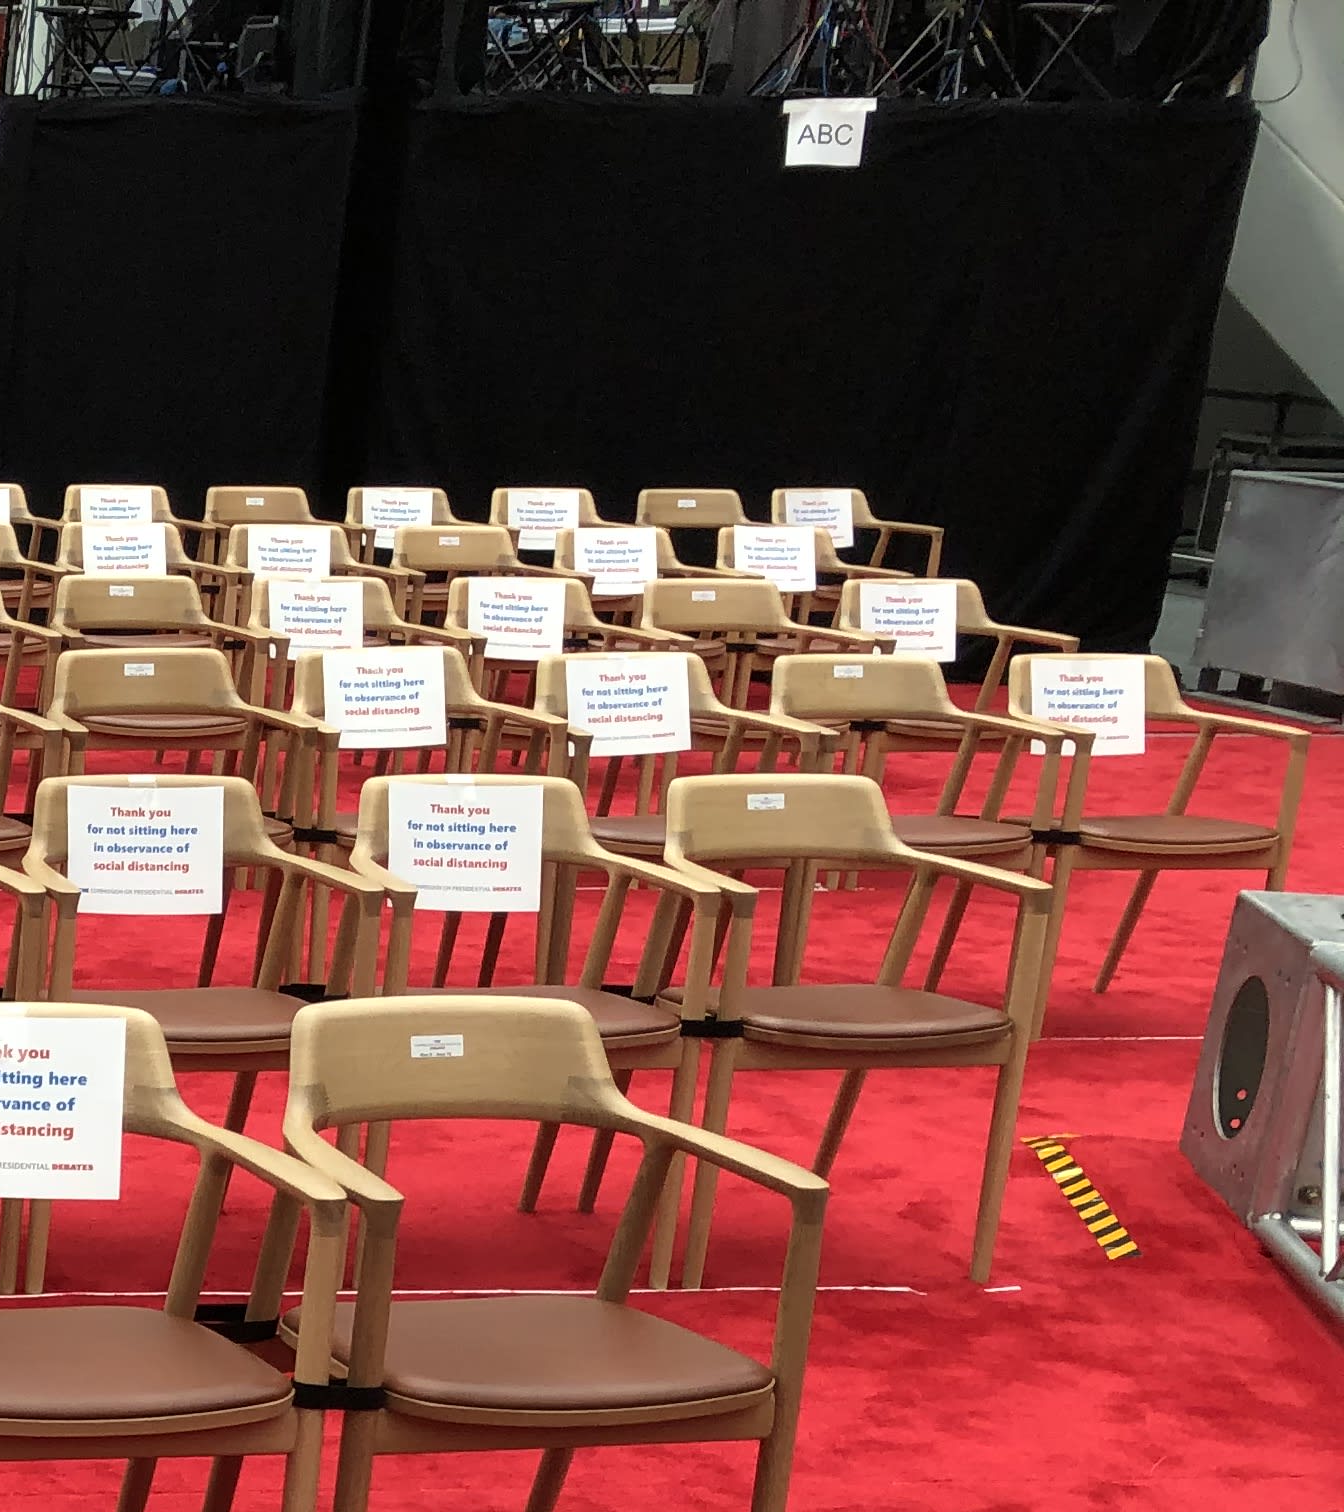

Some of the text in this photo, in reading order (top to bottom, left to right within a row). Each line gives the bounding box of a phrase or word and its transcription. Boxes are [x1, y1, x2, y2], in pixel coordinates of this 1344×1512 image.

[797, 124, 853, 145] ABC
[17, 1049, 50, 1063] you
[49, 1071, 88, 1086] here
[56, 1097, 76, 1111] of
